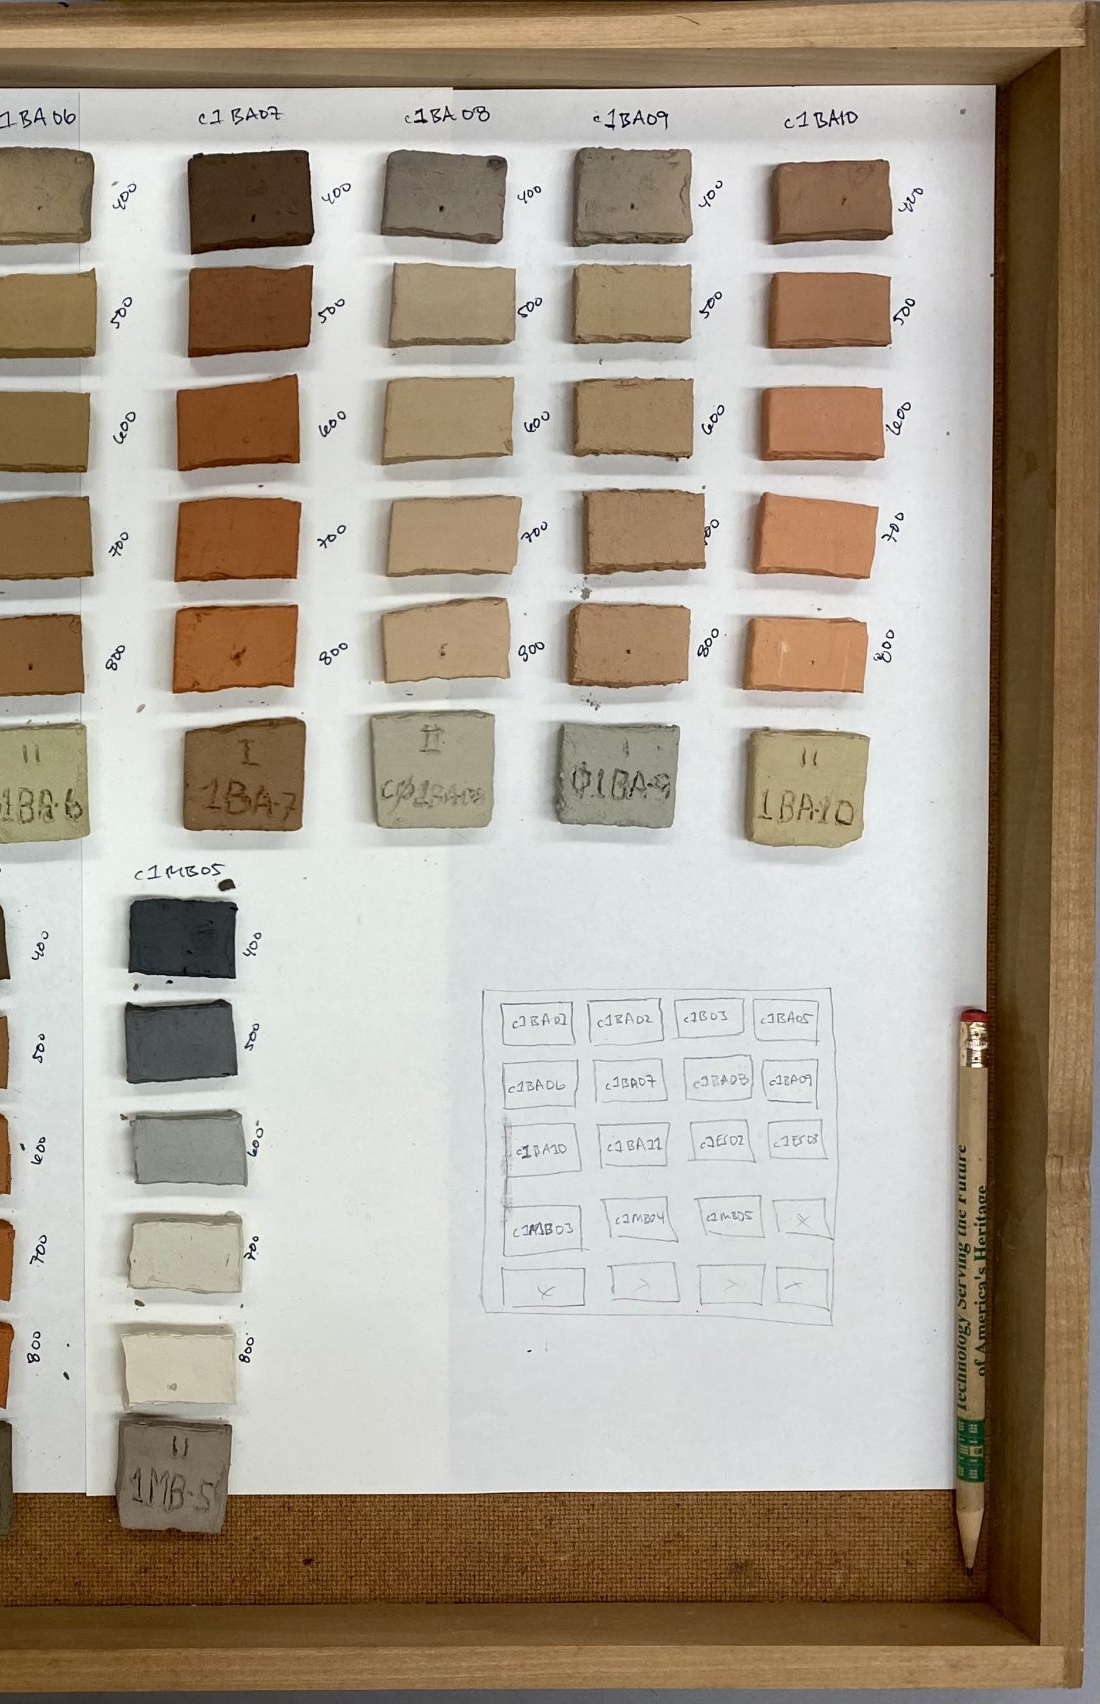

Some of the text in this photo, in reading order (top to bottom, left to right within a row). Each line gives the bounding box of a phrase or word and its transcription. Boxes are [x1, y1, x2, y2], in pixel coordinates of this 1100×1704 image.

[113, 184, 136, 209] 400
[517, 185, 541, 204] 400
[698, 180, 723, 209] 400
[110, 297, 132, 329] 500
[318, 299, 345, 324] 500
[517, 297, 542, 318] 500
[699, 291, 722, 319] 500
[893, 298, 915, 325] 500
[113, 411, 136, 444] 600
[318, 411, 346, 437] 600
[524, 411, 550, 432] 600
[701, 404, 724, 435] 600
[886, 401, 911, 436] 600
[317, 524, 346, 548] 700
[521, 521, 548, 543] 700
[882, 512, 904, 542] 700
[109, 532, 129, 557] 700
[319, 643, 348, 666] 800
[697, 628, 719, 658] 800
[105, 645, 126, 671] 800
[32, 931, 49, 961] 400
[243, 932, 261, 959] 400
[32, 1033, 45, 1062] 500
[245, 1023, 259, 1051] 500
[31, 1137, 46, 1165] 600
[247, 1127, 264, 1156] 600
[958, 1209, 967, 1237] the
[30, 1234, 47, 1264] 700
[244, 1236, 259, 1260] 700
[957, 1243, 971, 1309] Serving
[974, 1185, 987, 1377] of America's Heritage
[27, 1331, 40, 1364] 800
[238, 1337, 254, 1364] 800
